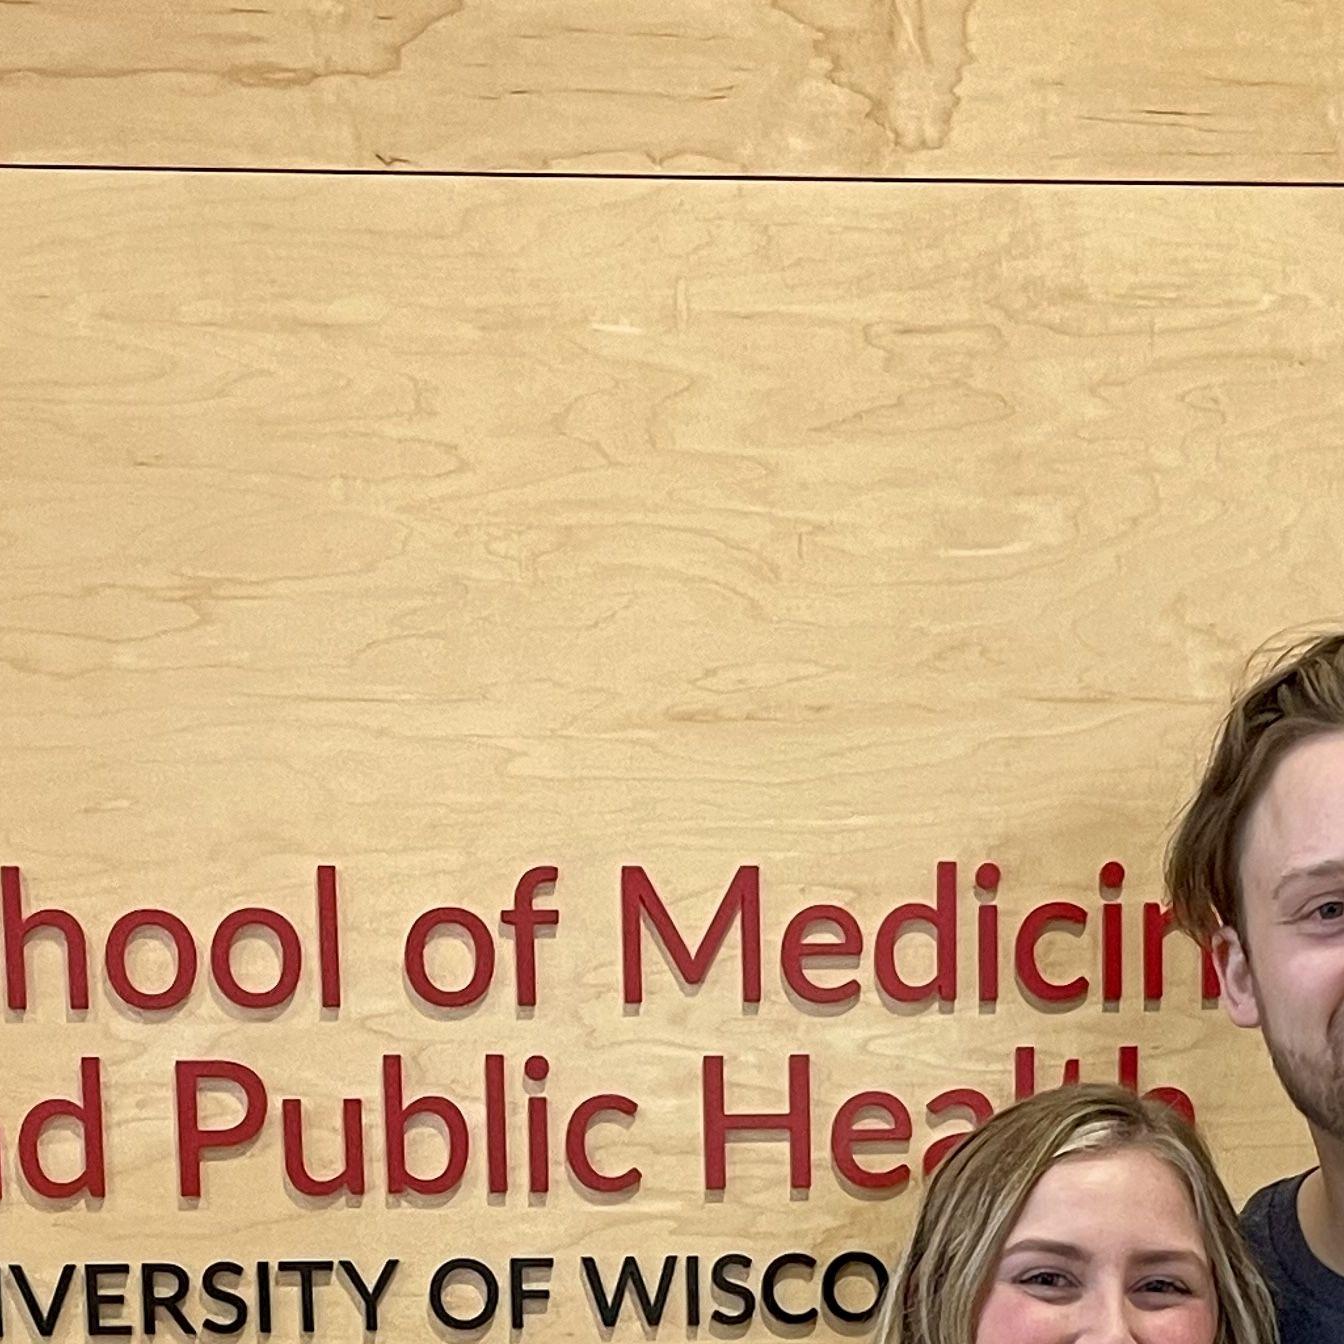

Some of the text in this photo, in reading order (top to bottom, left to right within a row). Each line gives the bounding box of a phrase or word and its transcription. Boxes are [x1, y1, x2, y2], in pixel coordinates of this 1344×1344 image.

[402, 864, 558, 1010] of
[620, 861, 1222, 1004] Medicin
[174, 1053, 642, 1199] Public
[429, 1257, 556, 1332] OF
[581, 1251, 890, 1330] WISCO
